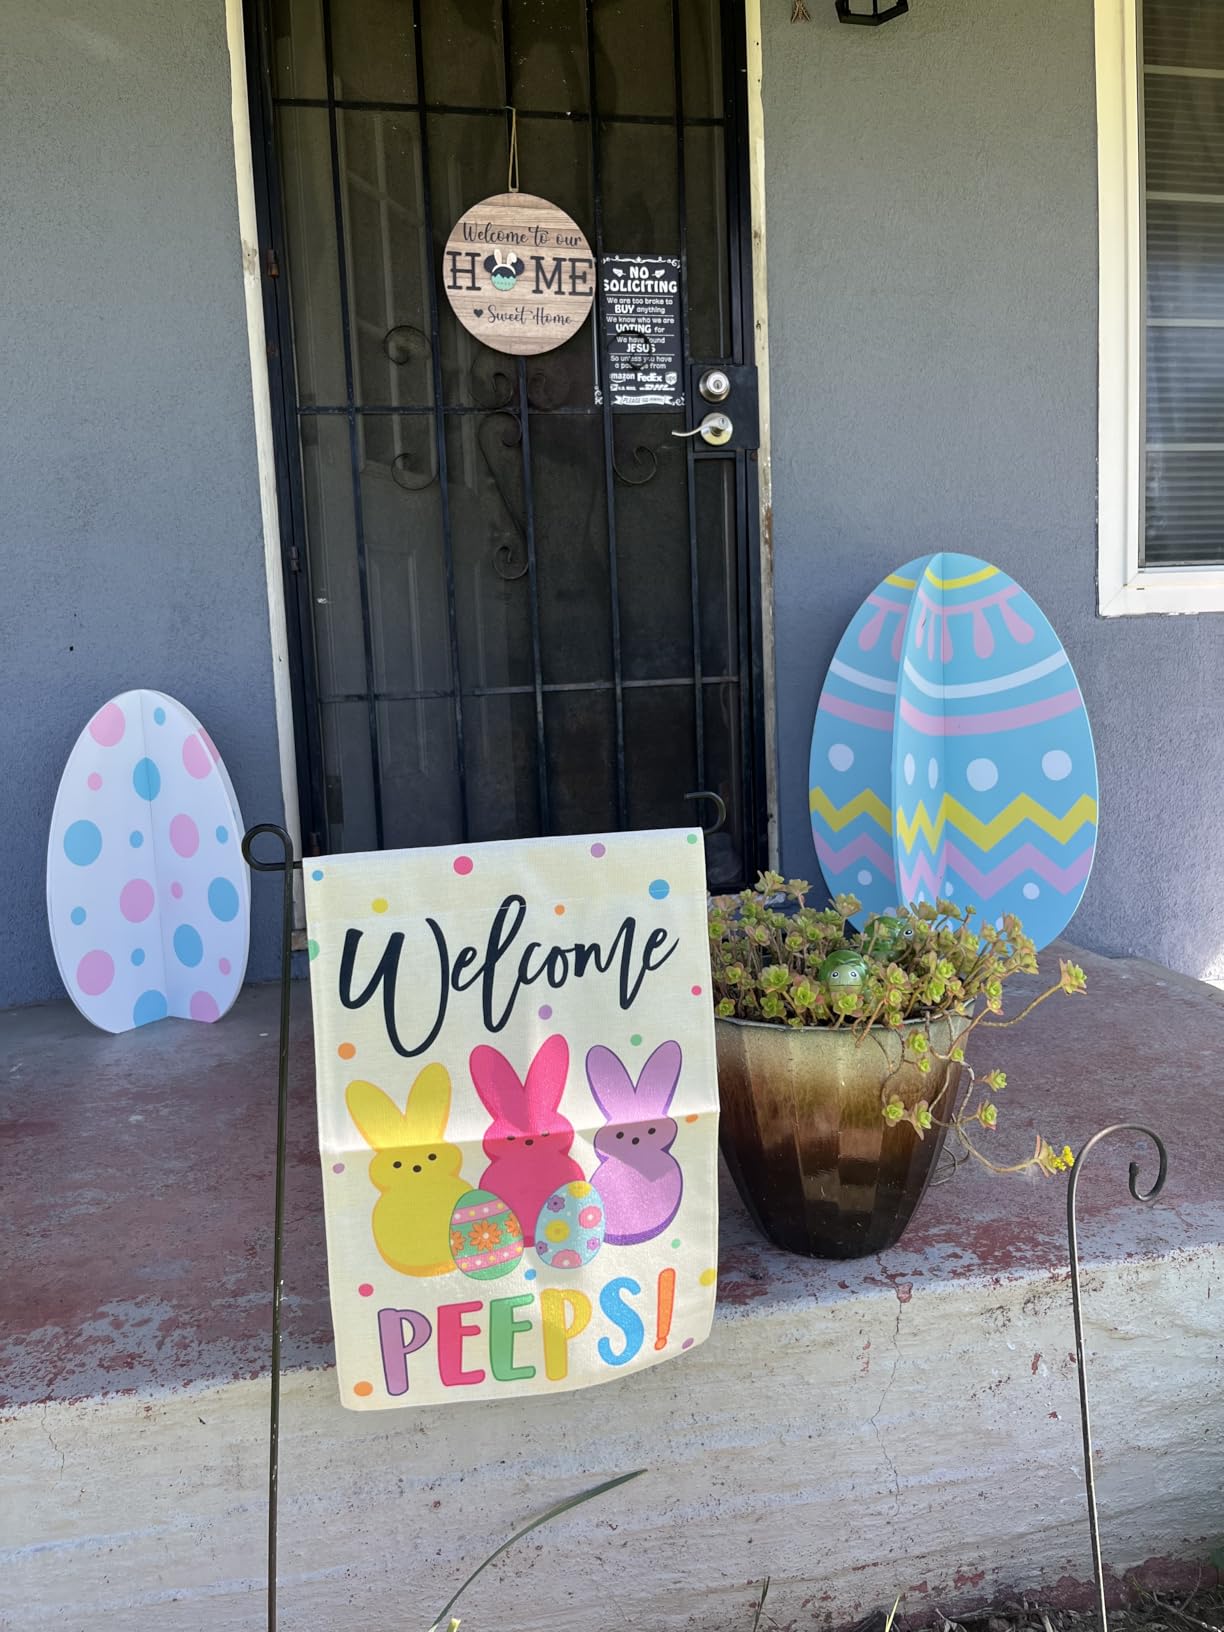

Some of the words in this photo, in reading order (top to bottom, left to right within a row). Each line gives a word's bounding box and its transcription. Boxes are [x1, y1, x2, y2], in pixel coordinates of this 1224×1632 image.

[463, 222, 528, 244] Welcome
[528, 225, 549, 245] to
[556, 233, 582, 247] our
[629, 266, 649, 279] NO
[603, 279, 678, 293] SOLICITING
[487, 304, 531, 324] Sweet
[533, 307, 577, 326] Home
[614, 304, 635, 314] BUY
[636, 306, 666, 315] anything
[647, 336, 665, 344] ound
[626, 343, 656, 353] JESUS
[636, 372, 663, 382] FedEx
[339, 894, 680, 1058] Welcome
[377, 1267, 676, 1397] PEEPS!
